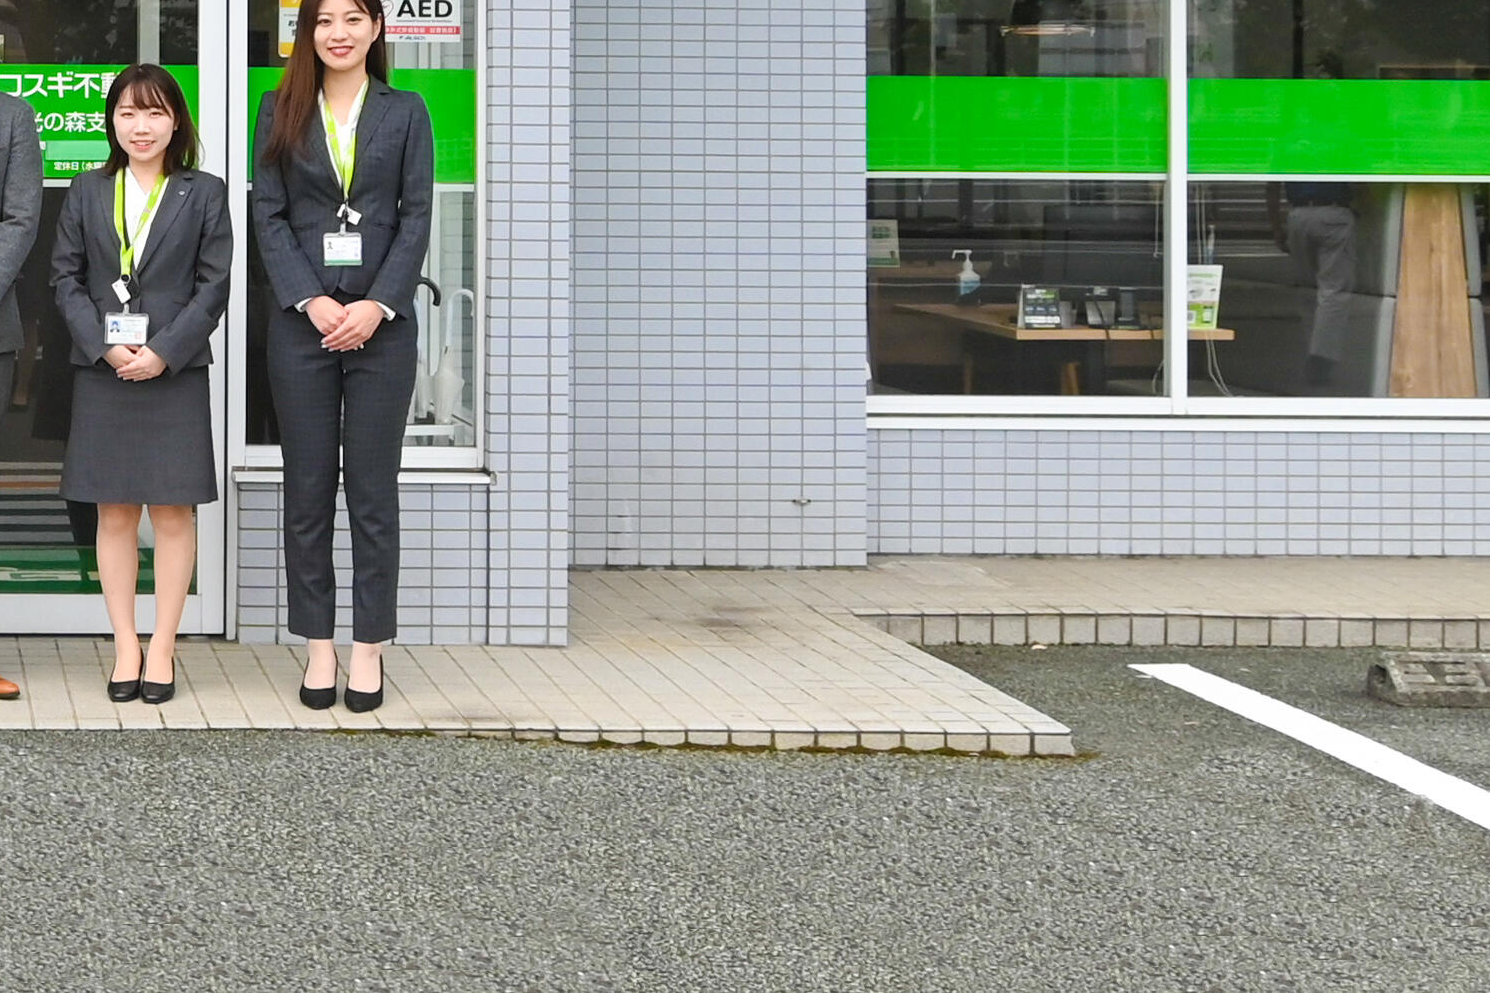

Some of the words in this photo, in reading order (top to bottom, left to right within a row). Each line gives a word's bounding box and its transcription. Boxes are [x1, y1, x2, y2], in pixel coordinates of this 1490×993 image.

[396, 0, 453, 18] AED
[34, 111, 107, 133] の森支
